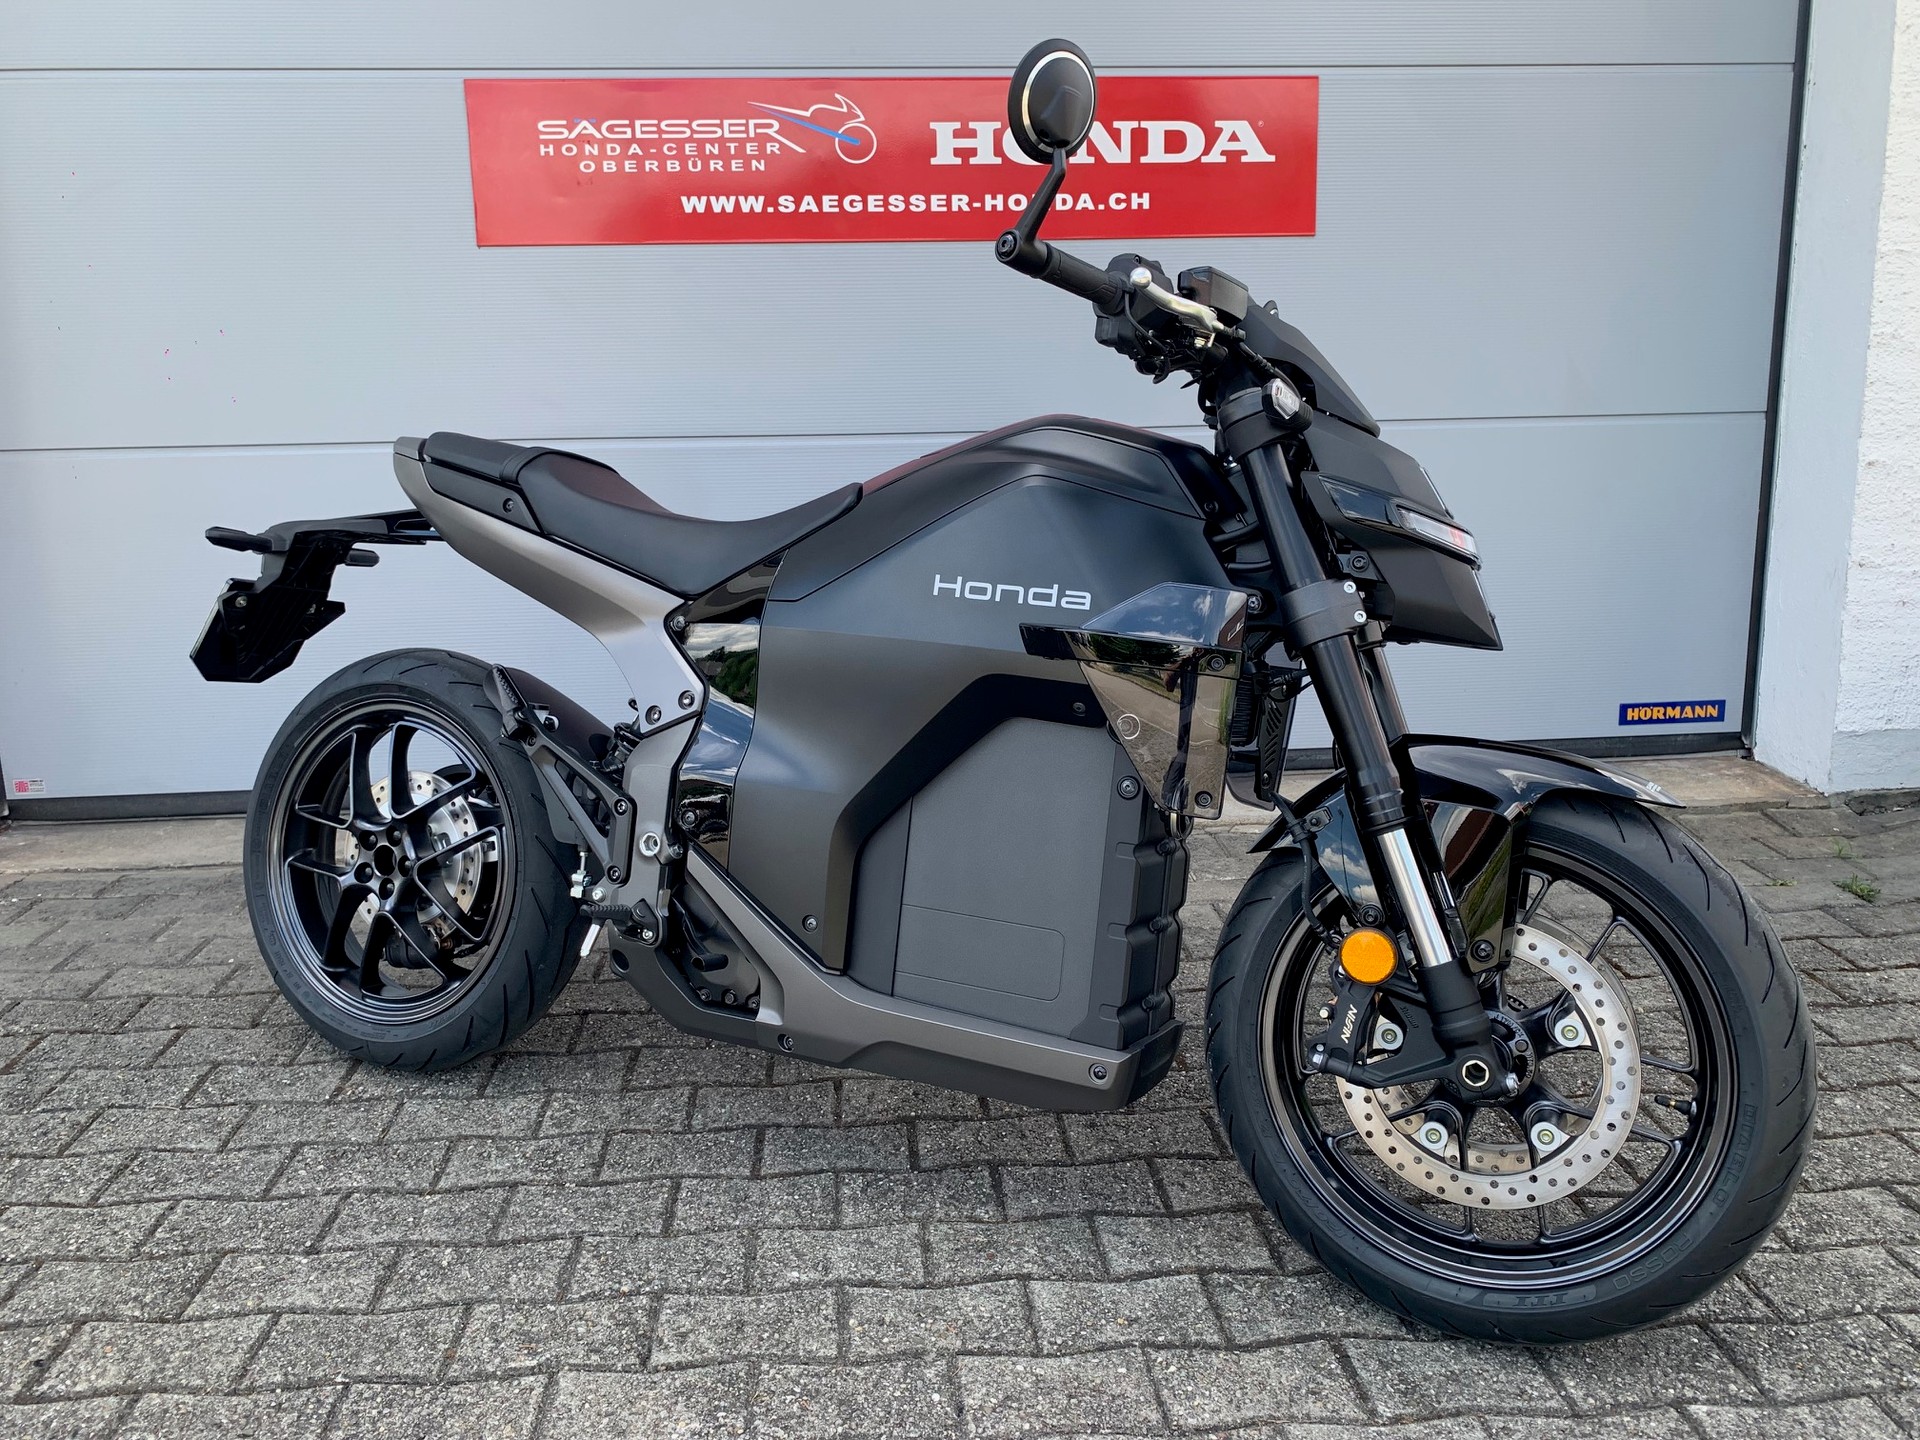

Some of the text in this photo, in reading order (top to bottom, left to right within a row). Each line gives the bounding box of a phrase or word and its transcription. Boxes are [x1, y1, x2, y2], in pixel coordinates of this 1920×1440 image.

[537, 117, 806, 152] SÄGESSER
[539, 142, 781, 157] HONDA-CENTER
[929, 120, 1276, 166] HNDA
[579, 157, 766, 173] OBERBÜREN
[680, 192, 1151, 214] WWW.SAEGESSER-HODA.CH
[932, 573, 1092, 611] Honda
[1626, 704, 1719, 721] HÖRMANN
[1713, 1103, 1757, 1206] DIABLO
[1613, 1233, 1694, 1291] ROSSO
